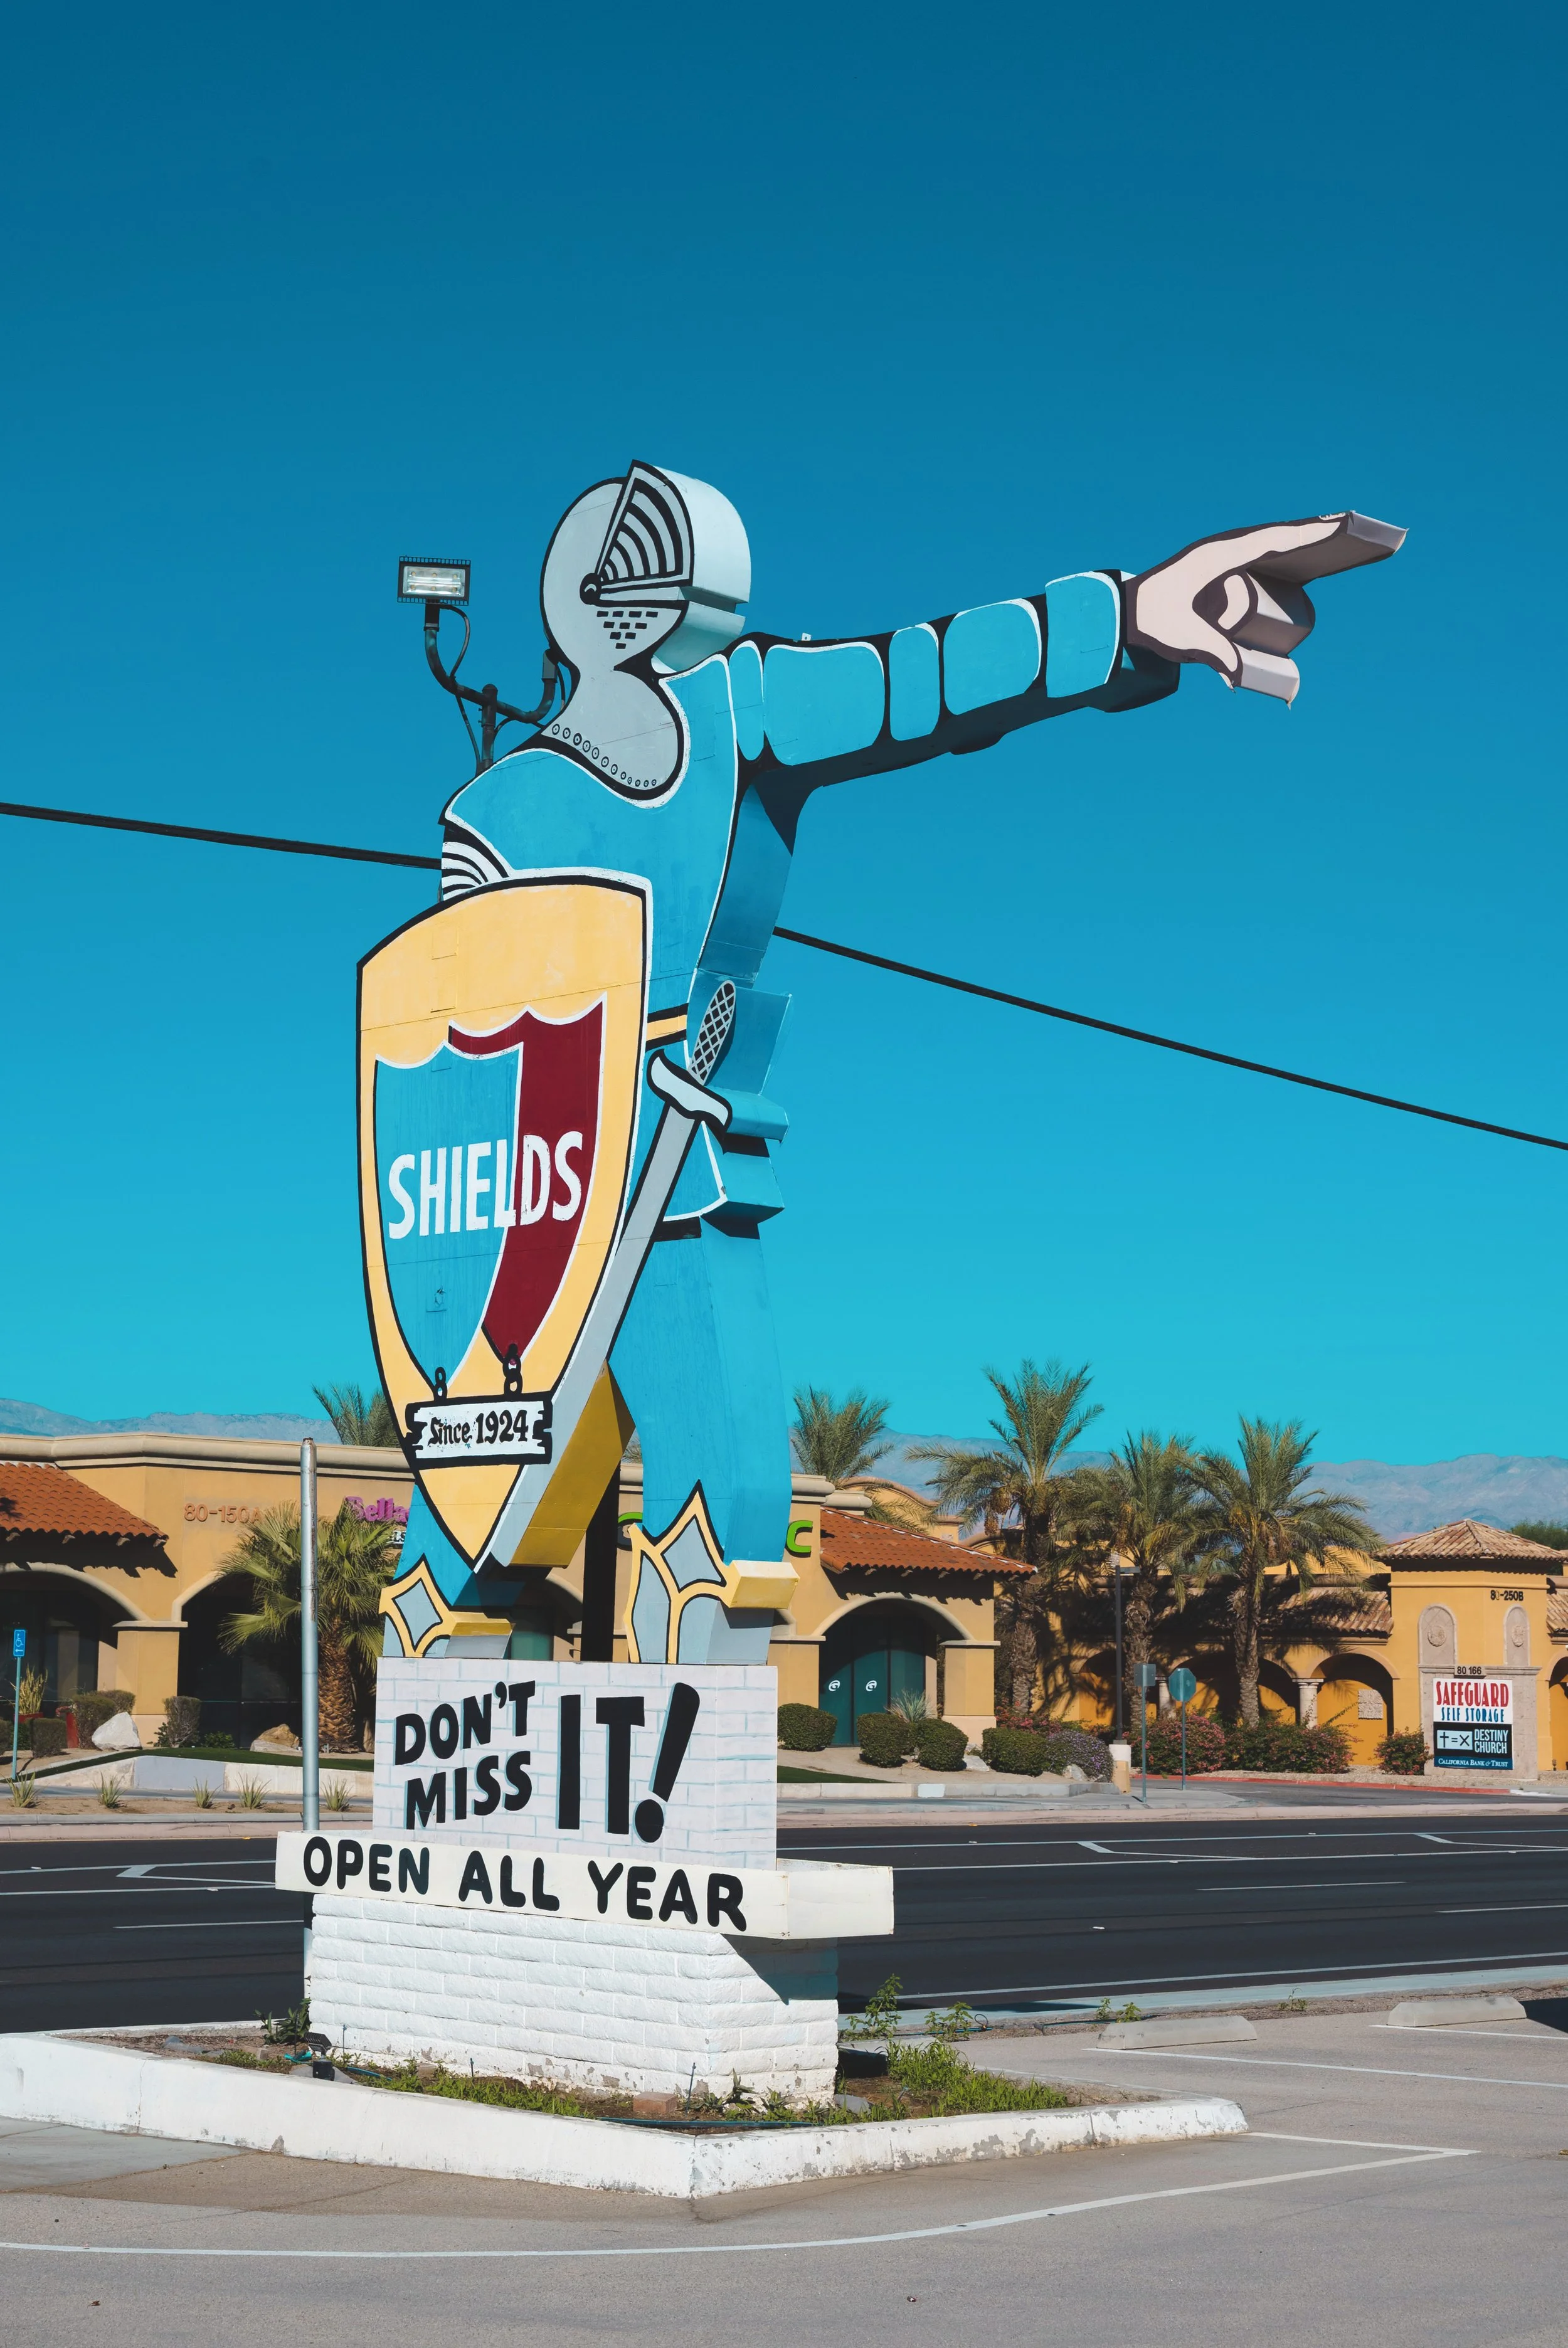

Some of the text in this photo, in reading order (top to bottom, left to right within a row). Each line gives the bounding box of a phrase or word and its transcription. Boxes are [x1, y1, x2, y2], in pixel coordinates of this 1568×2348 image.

[388, 1131, 583, 1240] SHIELDS
[428, 1409, 529, 1446] Since 1924
[184, 1503, 262, 1524] 80-150A
[343, 1496, 410, 1523] Bella
[1457, 1666, 1482, 1675] 80 166
[1436, 1681, 1509, 1707] SAFEGUARD
[394, 1680, 536, 1766] DON'T
[1441, 1707, 1504, 1723] SELF STORAGE
[1474, 1728, 1508, 1742] DESTINY
[1474, 1741, 1507, 1754] CHURCH
[556, 1682, 701, 1844] IT!
[405, 1750, 532, 1830] MISS
[303, 1836, 747, 1932] OPEN ALL YEAR
